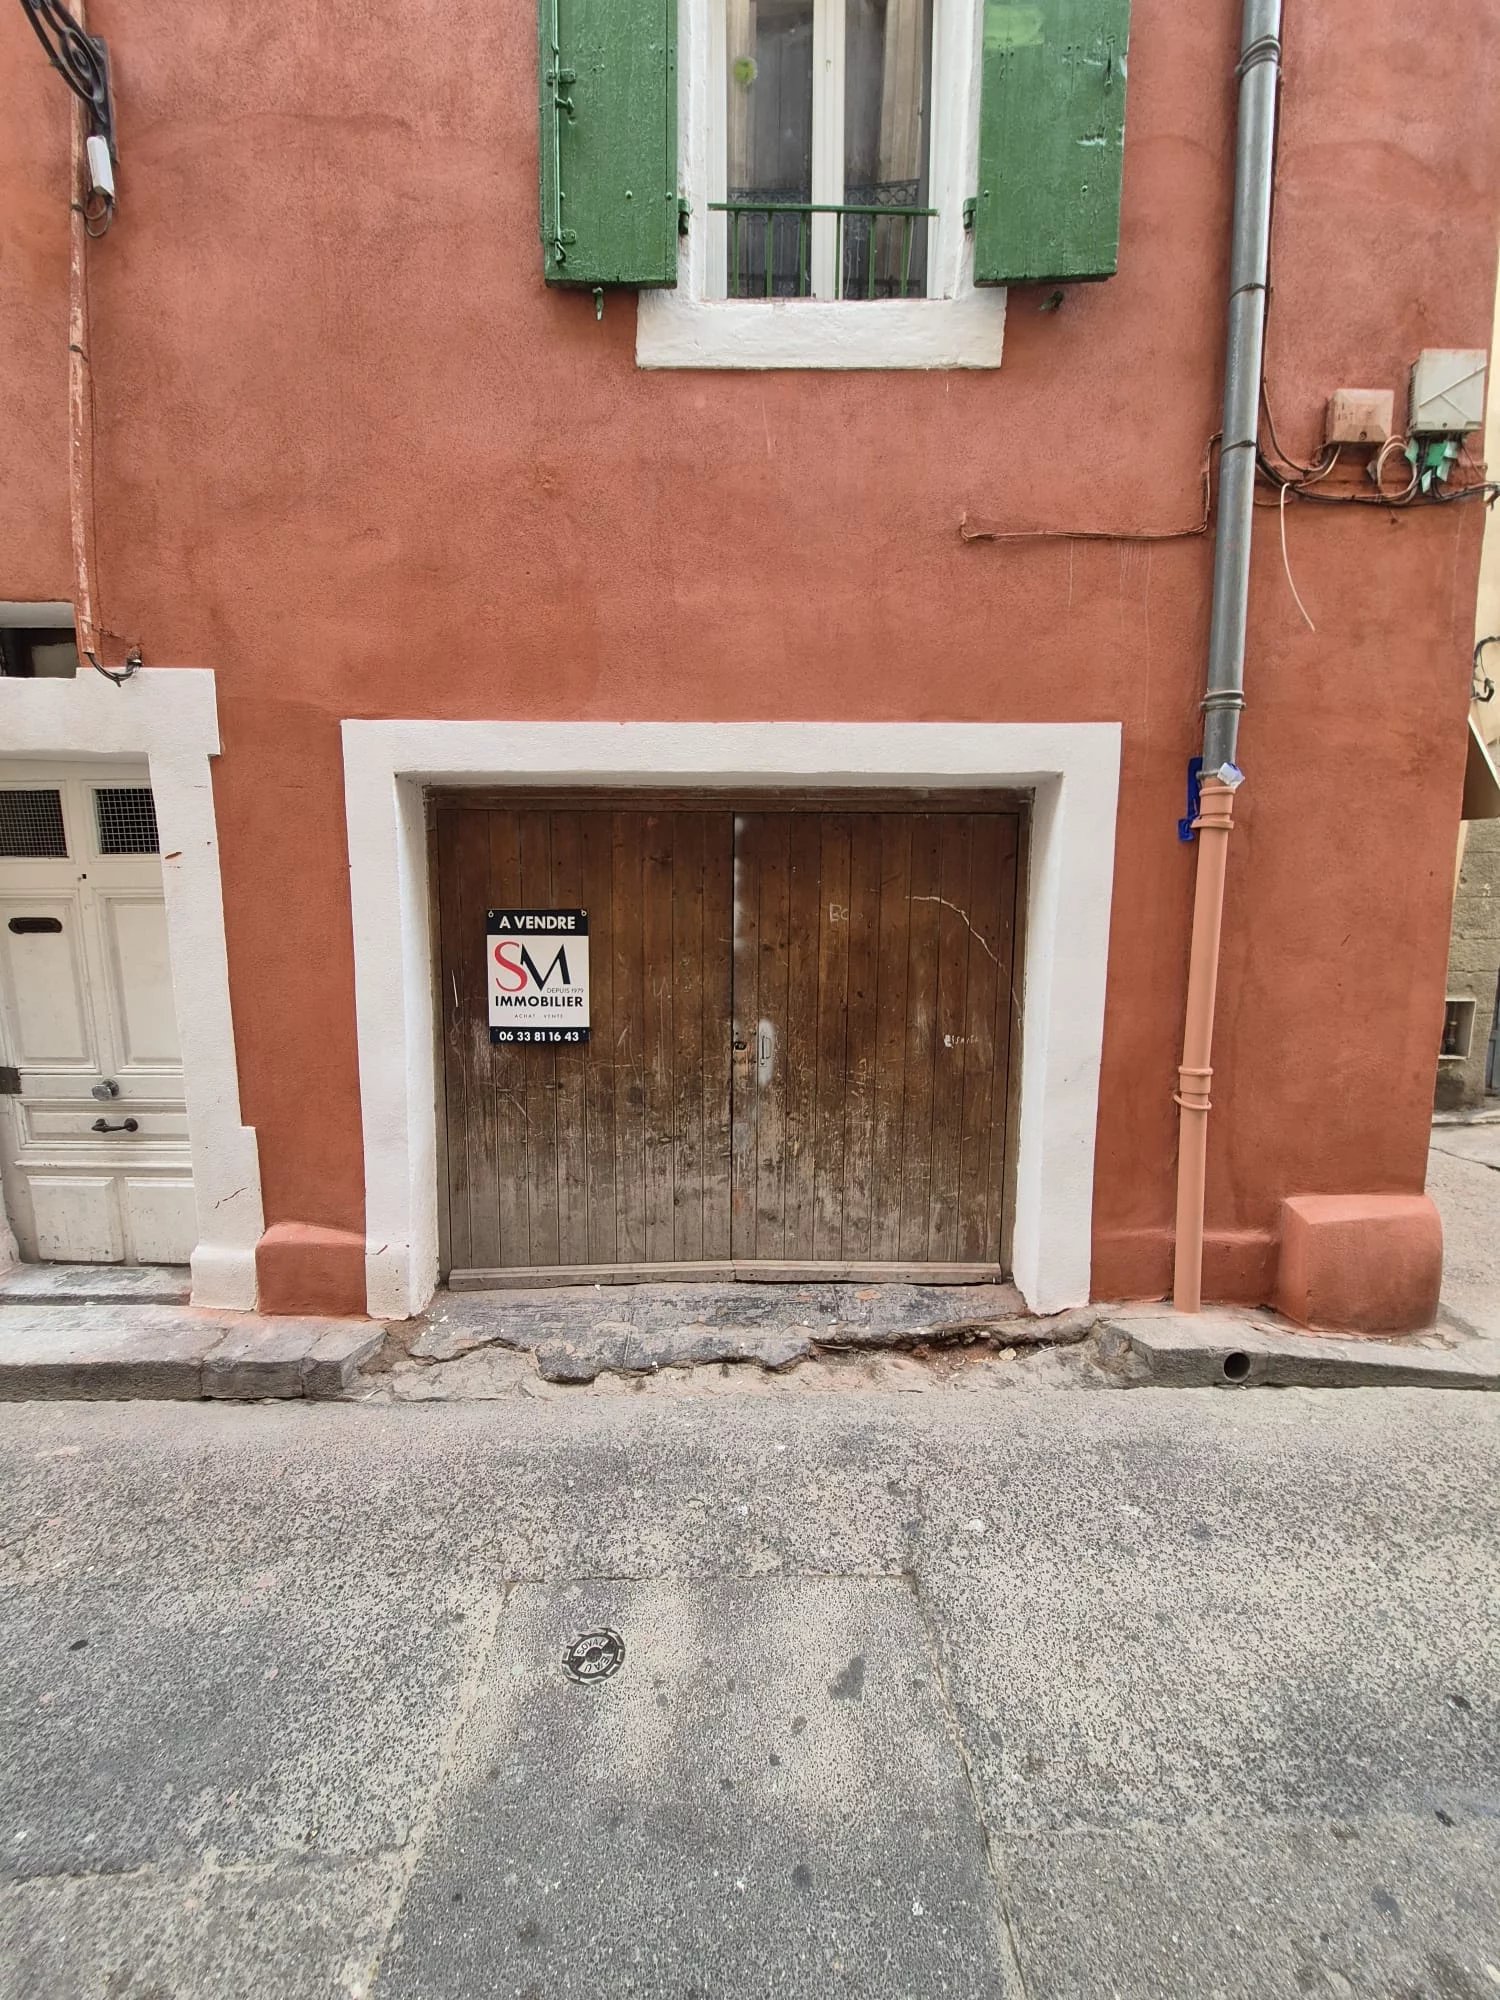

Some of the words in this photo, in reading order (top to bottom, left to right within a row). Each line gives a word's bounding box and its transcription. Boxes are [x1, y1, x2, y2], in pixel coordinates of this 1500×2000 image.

[499, 915, 512, 929] A
[514, 915, 576, 930] VENDRE
[494, 941, 571, 992] SM
[495, 995, 583, 1007] IMMOBILIER
[499, 1031, 514, 1041] 06
[516, 1031, 531, 1041] 33
[534, 1031, 546, 1042] 81
[548, 1031, 562, 1042] 16
[564, 1031, 579, 1042] 43
[584, 1656, 610, 1672] EAU
